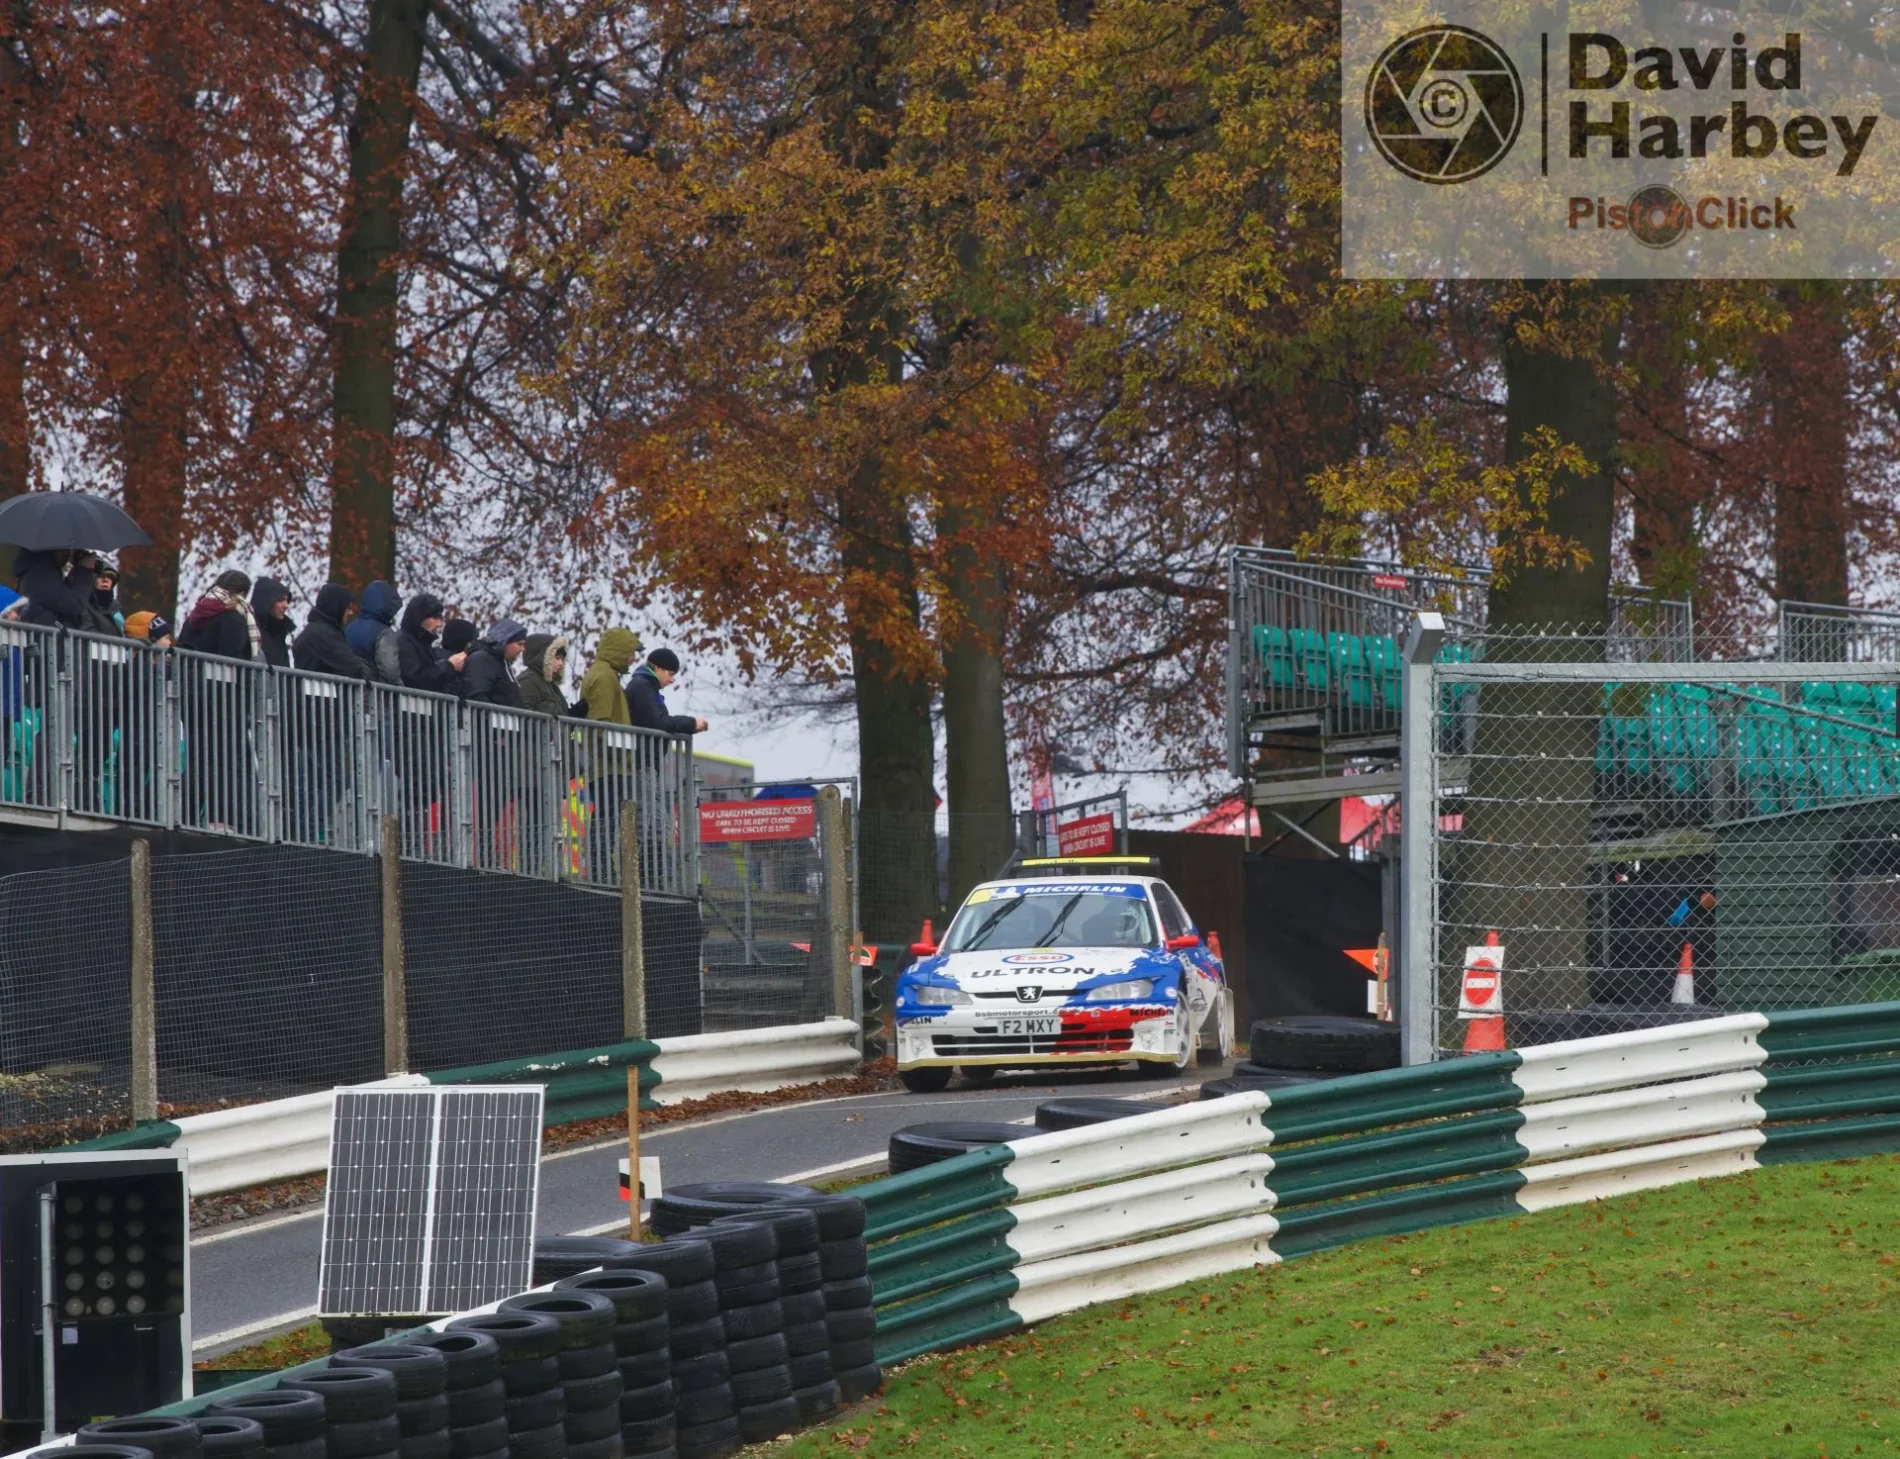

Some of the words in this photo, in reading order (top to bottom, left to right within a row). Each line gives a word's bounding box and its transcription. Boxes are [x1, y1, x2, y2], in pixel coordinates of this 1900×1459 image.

[701, 811, 714, 820] NO
[716, 807, 780, 819] UNAUTHORISED
[782, 805, 813, 815] ACCESS
[1091, 822, 1110, 834] CLOSED
[1094, 835, 1106, 846] LIVE
[971, 966, 1095, 979] ULTRON
[1003, 1020, 1022, 1034] F2
[1026, 1020, 1054, 1033] MXY
